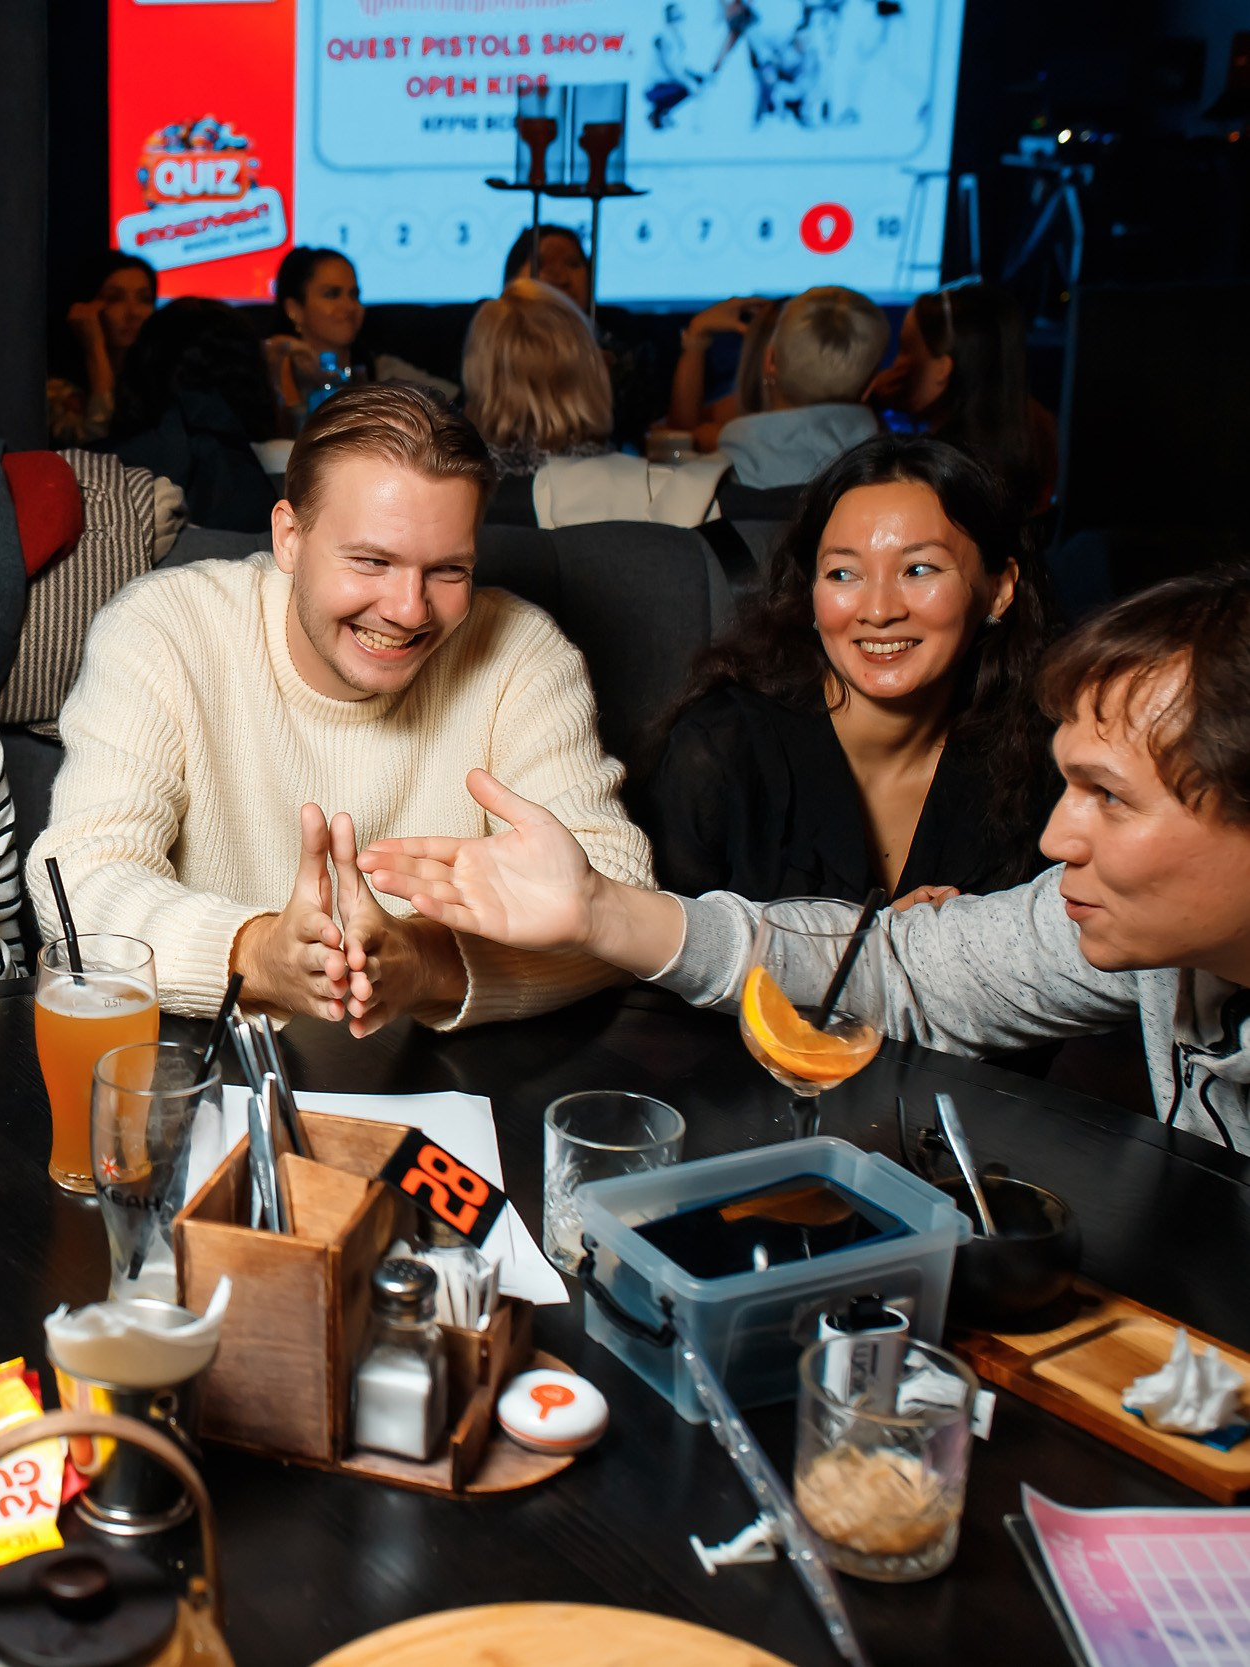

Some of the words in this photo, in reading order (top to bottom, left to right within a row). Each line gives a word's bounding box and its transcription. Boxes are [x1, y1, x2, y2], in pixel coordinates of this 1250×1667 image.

[326, 36, 411, 61] QUEST
[421, 33, 531, 57] PISTOLS
[406, 74, 477, 98] OPEN
[154, 159, 241, 197] QUIZ
[338, 222, 349, 246] 1
[398, 221, 411, 247] 2
[456, 220, 470, 246] 3
[636, 218, 651, 243] 6
[699, 216, 713, 242] 7
[759, 215, 773, 242] 8
[876, 215, 901, 240] 10
[399, 1144, 490, 1236] 28
